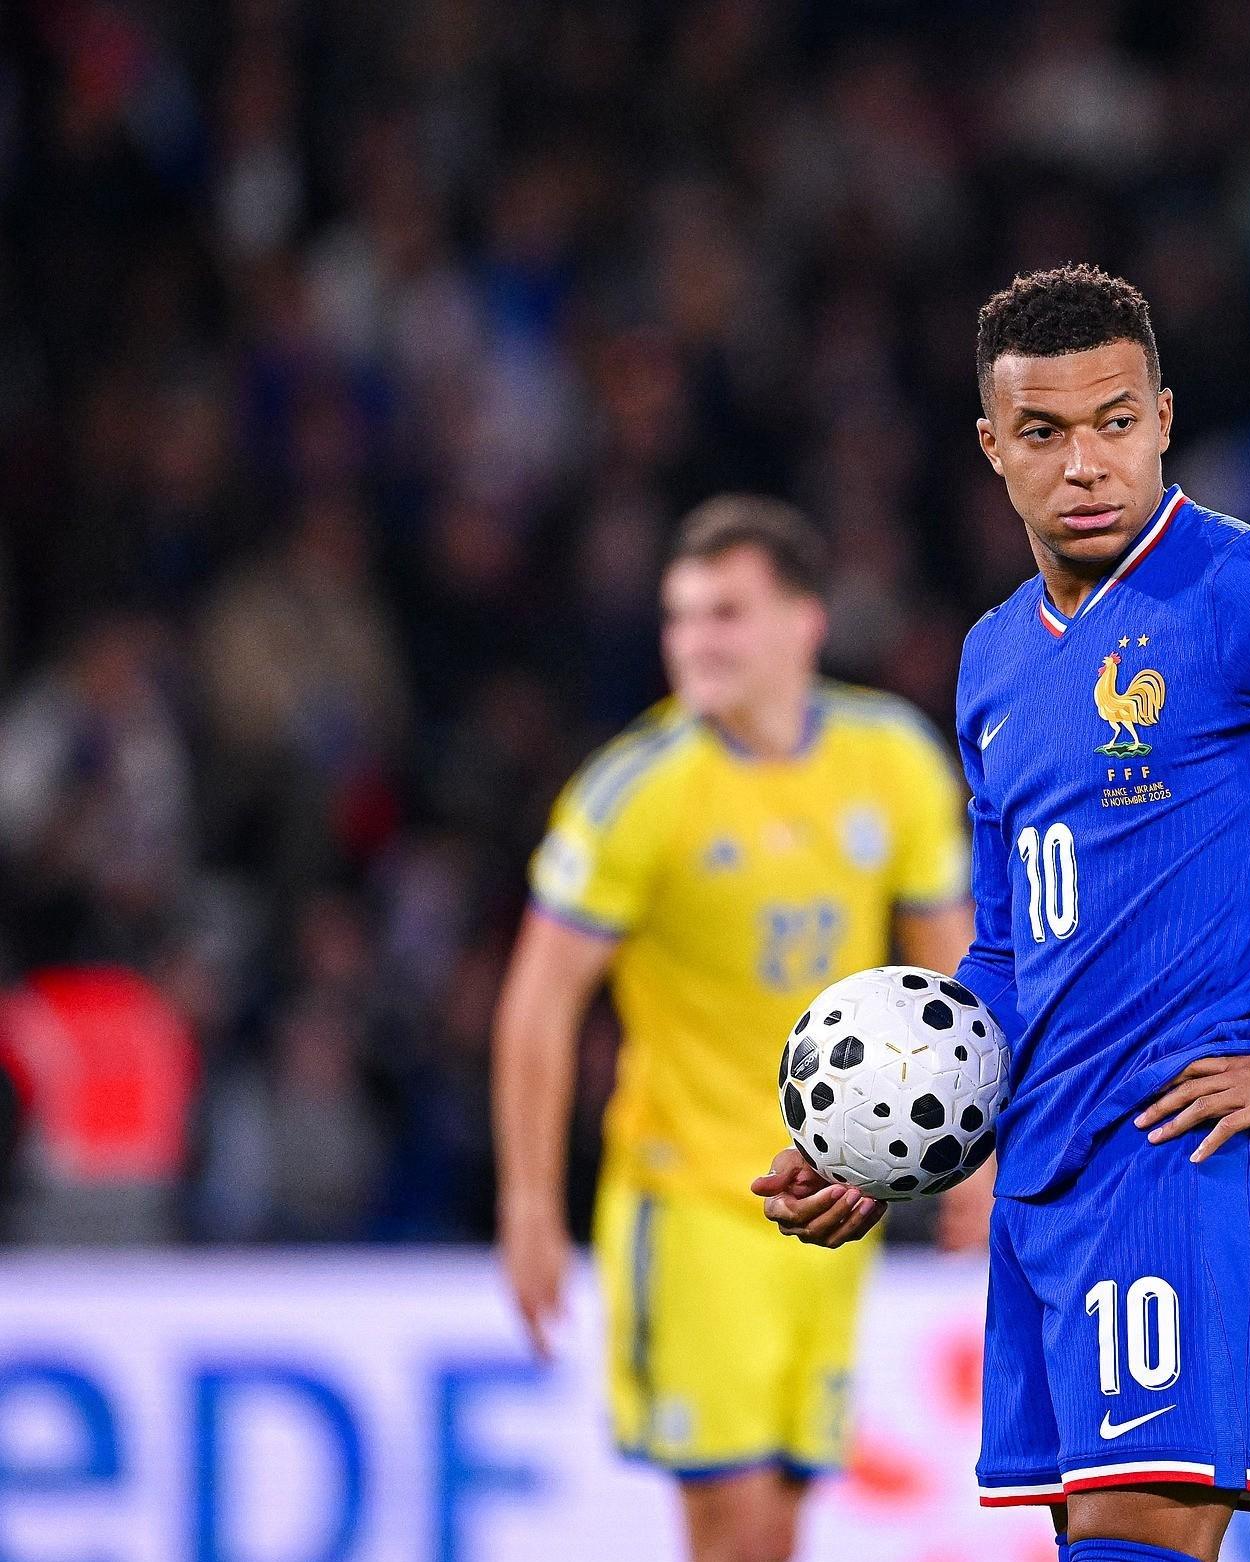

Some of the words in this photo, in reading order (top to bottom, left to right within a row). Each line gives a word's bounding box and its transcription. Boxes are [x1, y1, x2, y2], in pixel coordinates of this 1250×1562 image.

[1101, 798, 1109, 808] 13
[1110, 796, 1148, 807] NOVEMBRE
[1148, 789, 1172, 802] 2025
[1103, 787, 1128, 797] FRANCE
[1134, 781, 1164, 794] UKRAINE
[1016, 822, 1080, 943] 10
[1085, 1275, 1181, 1396] 10
